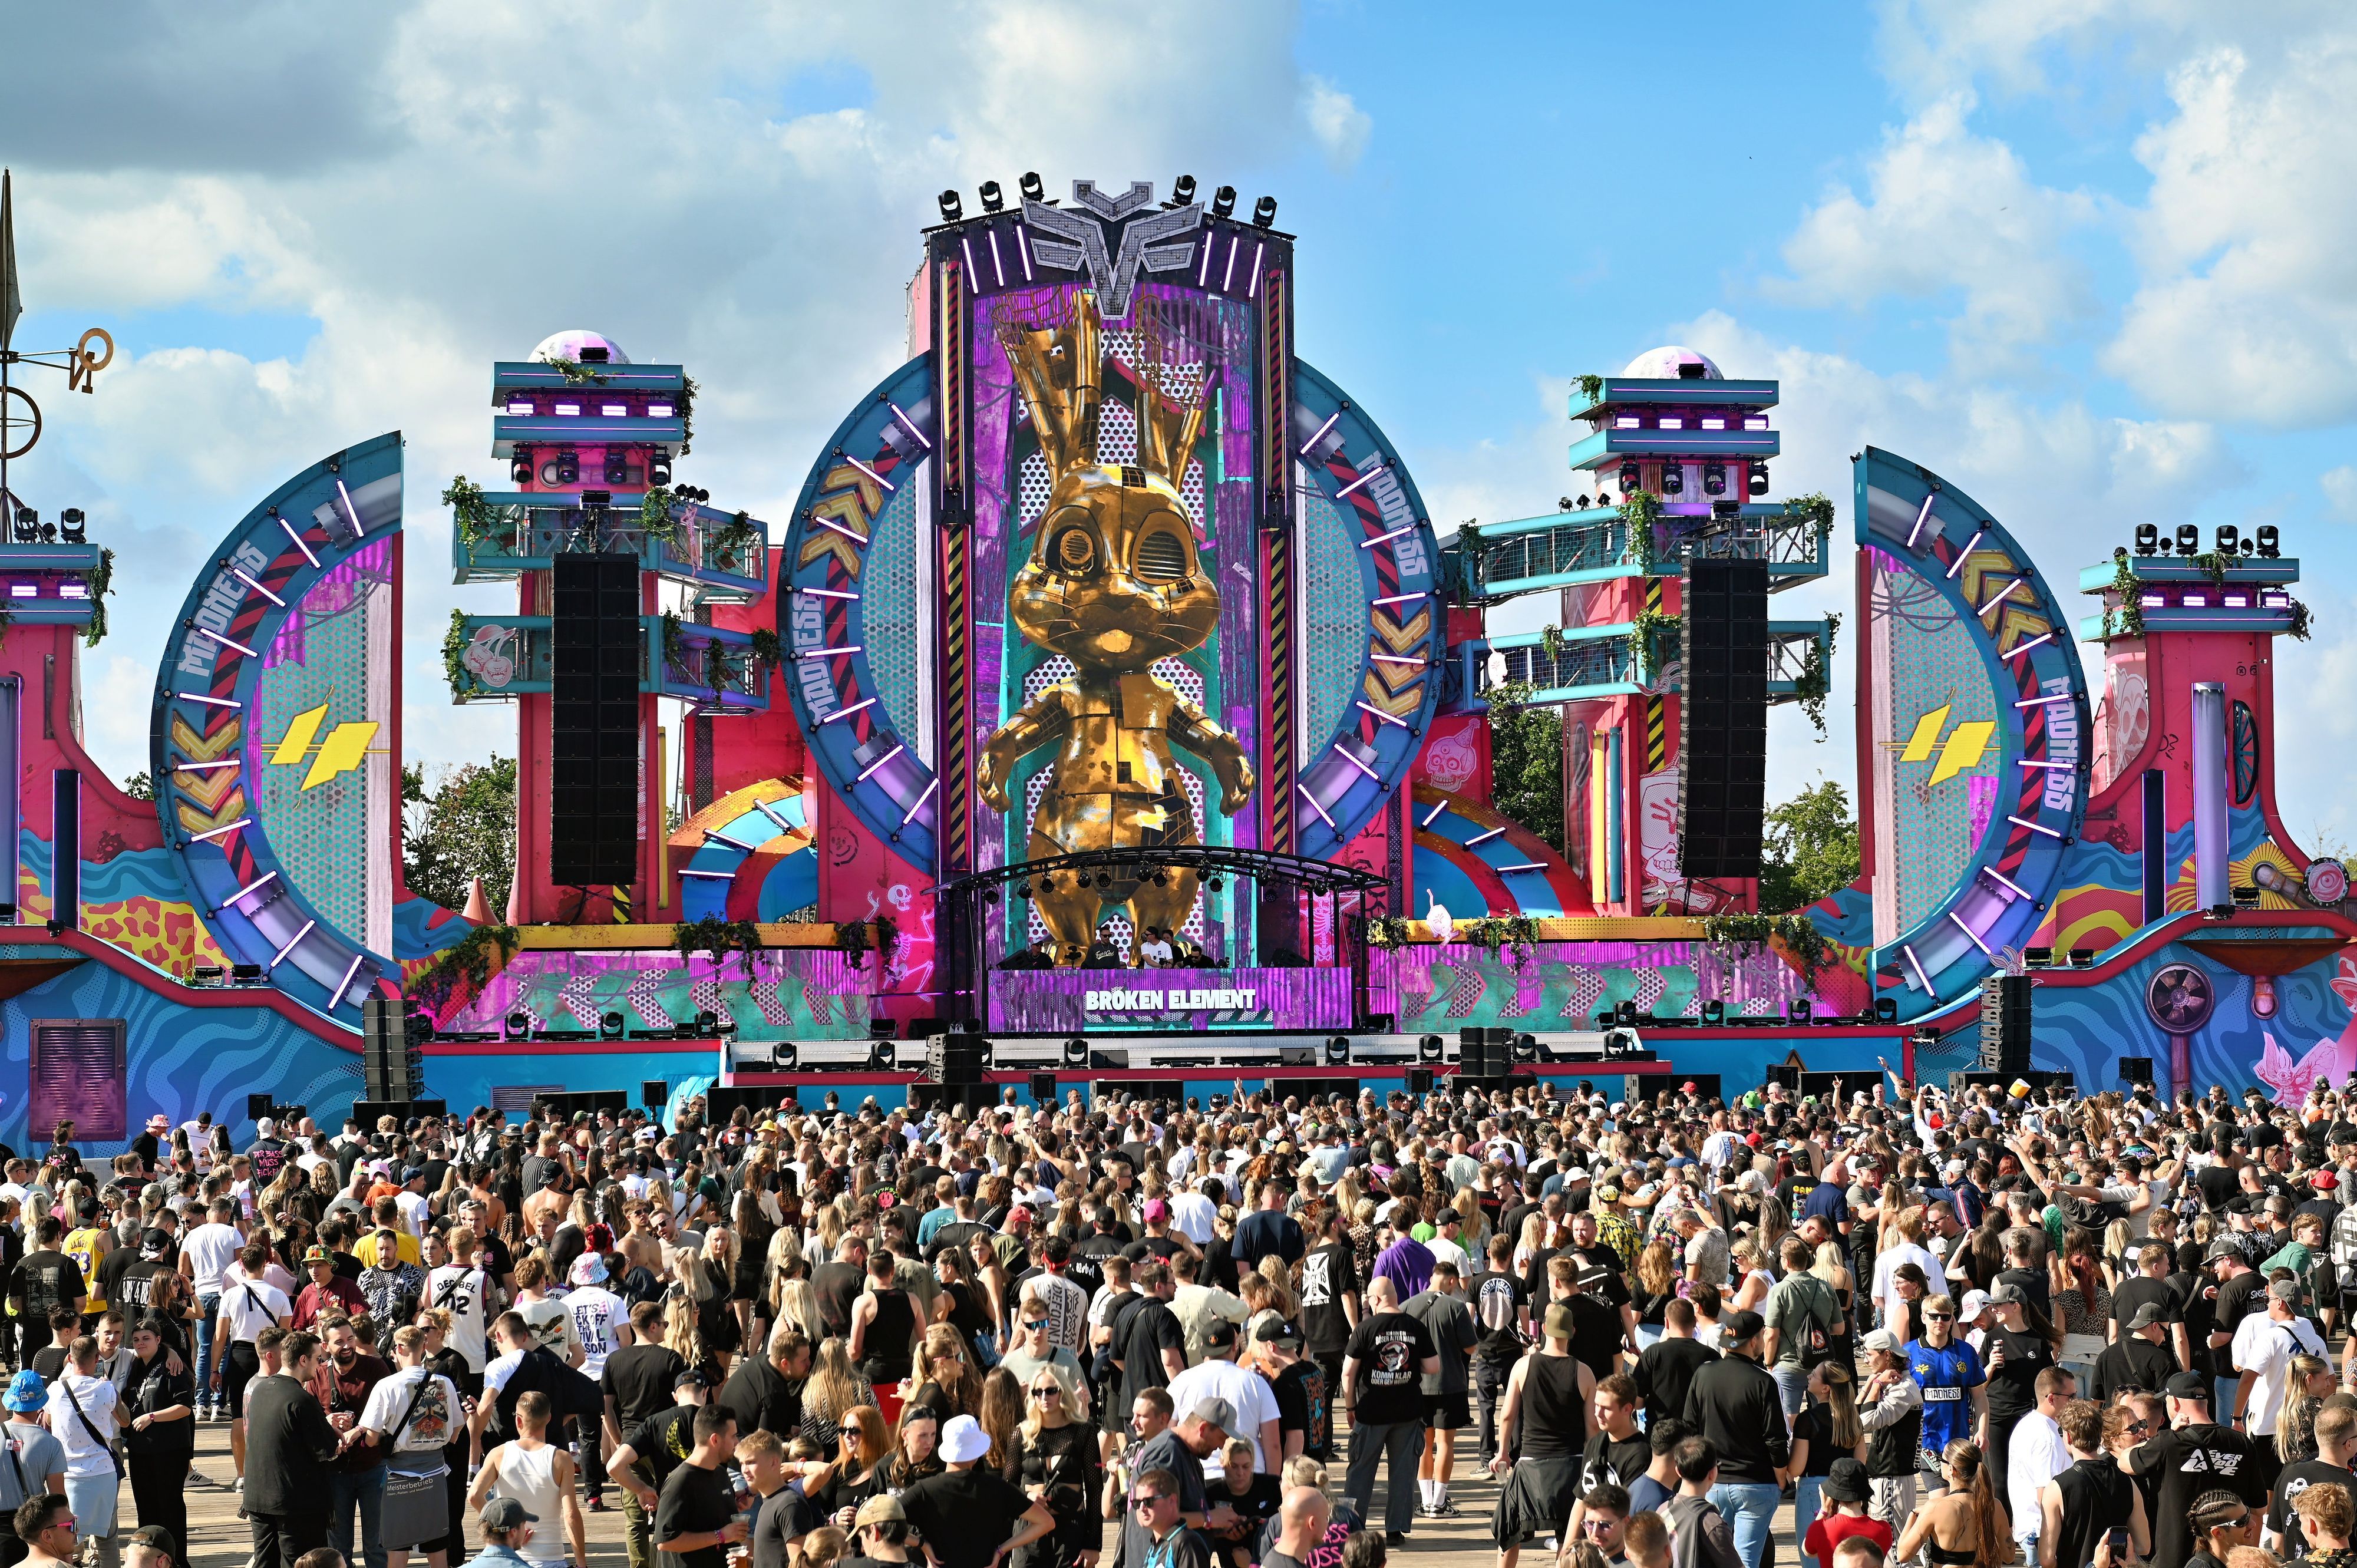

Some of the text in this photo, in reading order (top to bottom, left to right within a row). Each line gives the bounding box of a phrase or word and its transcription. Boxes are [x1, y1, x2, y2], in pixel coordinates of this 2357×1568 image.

[1356, 450, 1428, 576] MADNESS
[177, 540, 268, 677] MADNESS
[793, 592, 840, 725] MADNESS
[1086, 989, 1256, 1011] BROKEN ELEMENT
[259, 1158, 278, 1167] MUSS
[265, 1150, 282, 1158] BASS
[71, 1240, 88, 1249] JAMES
[69, 1252, 91, 1274] 23
[437, 1280, 476, 1294] DECBEL
[1371, 1369, 1412, 1379] KOMM KLAR
[1926, 1388, 1960, 1399] MADNESS
[387, 1478, 433, 1492] Meisterbetrieb
[1322, 1523, 1350, 1543] ASS
[1305, 1546, 1342, 1568] USS
